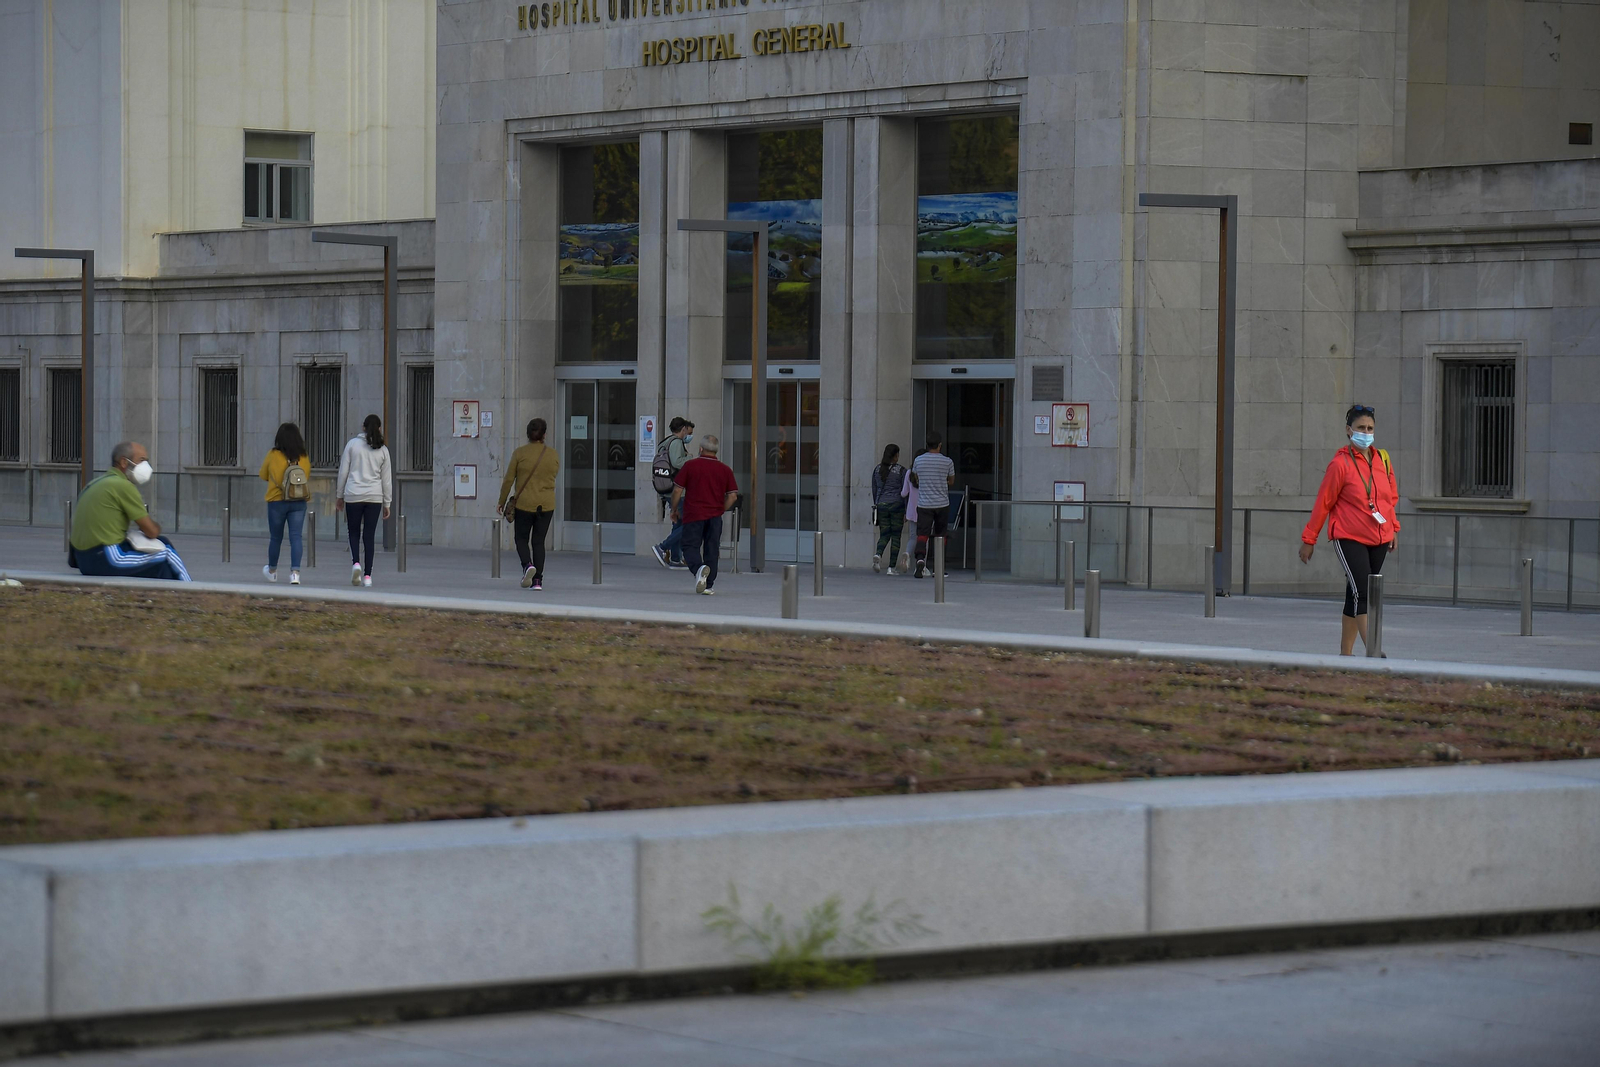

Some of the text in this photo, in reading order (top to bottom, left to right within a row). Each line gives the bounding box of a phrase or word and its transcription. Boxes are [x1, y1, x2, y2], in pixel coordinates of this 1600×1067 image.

[517, 0, 600, 30] HOSPITAL
[642, 22, 851, 66] HOSPITAL GENERAL
[655, 468, 670, 476] FILA
